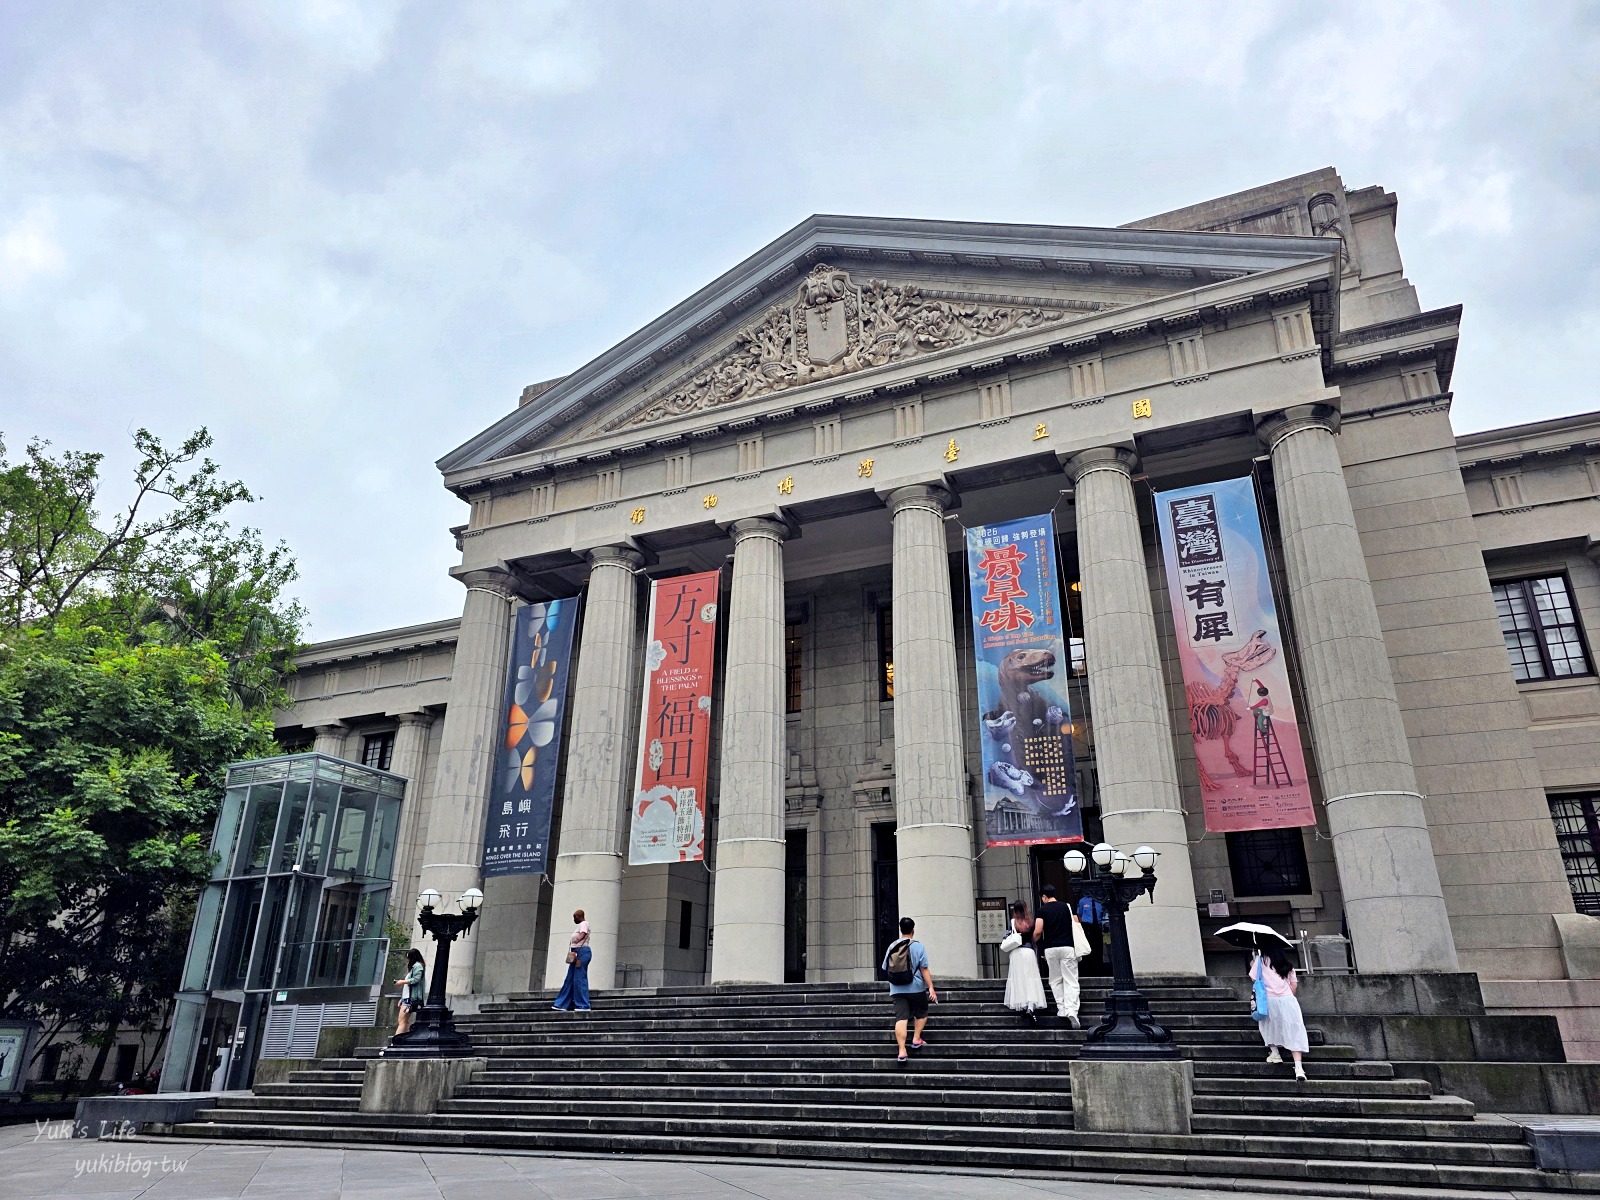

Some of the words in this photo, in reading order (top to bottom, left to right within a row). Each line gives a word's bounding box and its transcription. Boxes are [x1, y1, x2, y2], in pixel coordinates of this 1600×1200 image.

[976, 528, 998, 539] 2026
[1172, 500, 1218, 559] 臺灣
[978, 543, 1035, 633] 骨早味
[1185, 578, 1233, 642] 有犀
[664, 585, 703, 665] 方寸
[656, 673, 696, 685] BLESSINGS
[669, 667, 691, 677] FIELD
[661, 682, 677, 692] THE
[678, 680, 698, 691] PALM
[654, 693, 697, 782] 福田
[502, 799, 531, 815] 島嶼
[499, 822, 528, 838] 飛行
